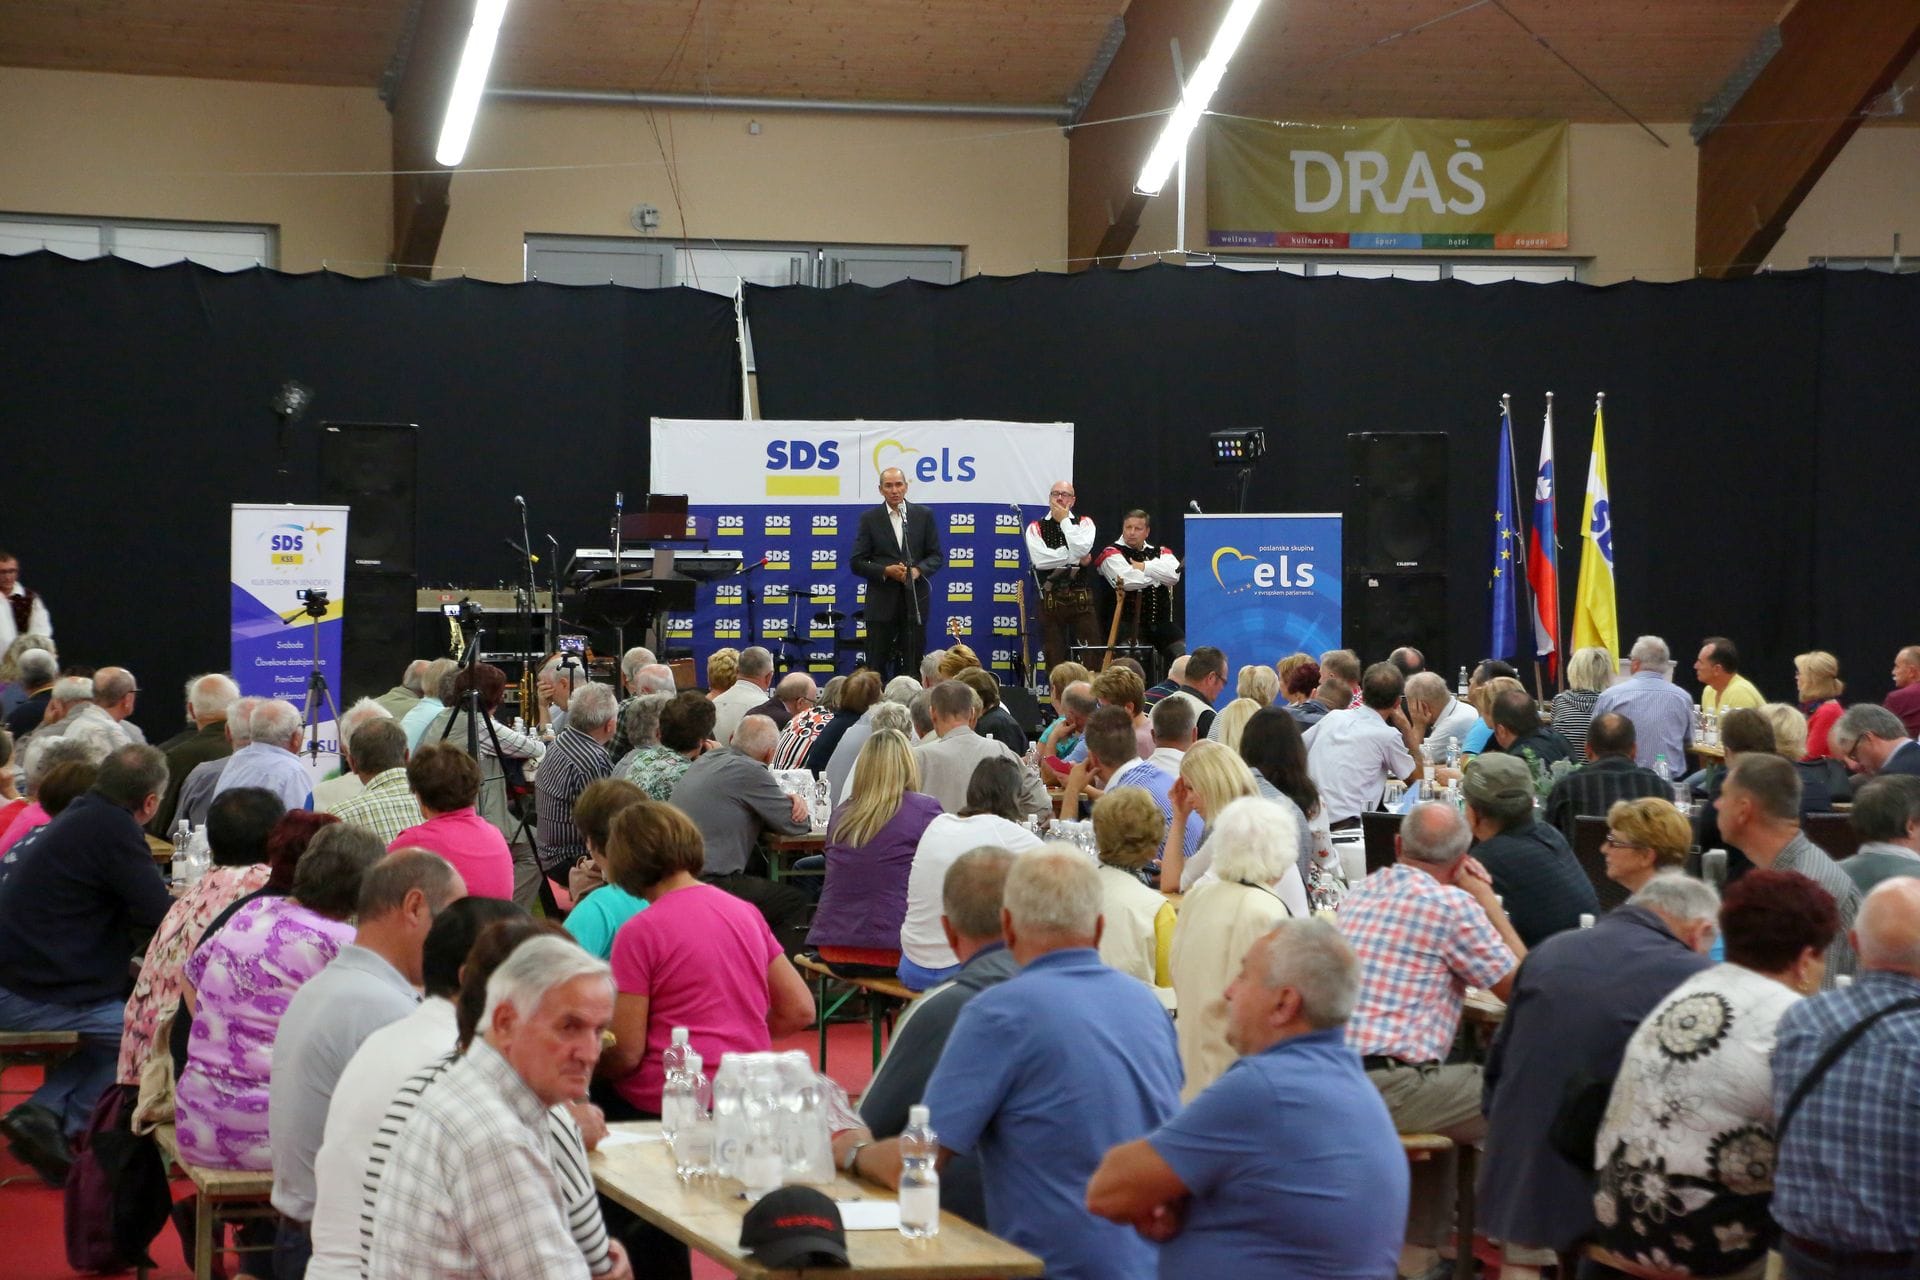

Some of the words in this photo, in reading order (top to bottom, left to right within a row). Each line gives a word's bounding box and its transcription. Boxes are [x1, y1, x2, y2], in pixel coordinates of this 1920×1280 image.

[1290, 138, 1486, 215] DRAŠ
[1291, 237, 1334, 245] kulinarika
[1448, 238, 1469, 246] hotel
[765, 439, 839, 471] SDS
[915, 447, 976, 483] els
[718, 515, 744, 527] SDS
[765, 515, 791, 527] SDS
[812, 515, 838, 527] SDS
[950, 513, 975, 525] SDS
[995, 514, 1020, 526] SDS
[271, 534, 304, 551] SDS
[765, 550, 790, 562] SDS
[812, 550, 837, 562] SDS
[949, 548, 974, 560] SDS
[994, 549, 1020, 560] SDS
[1254, 555, 1315, 588] els
[716, 585, 742, 596] SDS
[810, 583, 836, 595] SDS
[948, 582, 973, 593] SDS
[993, 582, 1018, 593] SDS
[667, 619, 693, 630] SDS
[714, 619, 741, 630] SDS
[762, 618, 789, 630] SDS
[993, 616, 1018, 627] SDS
[276, 640, 304, 649] Svoboda
[288, 657, 326, 668] dostojanva
